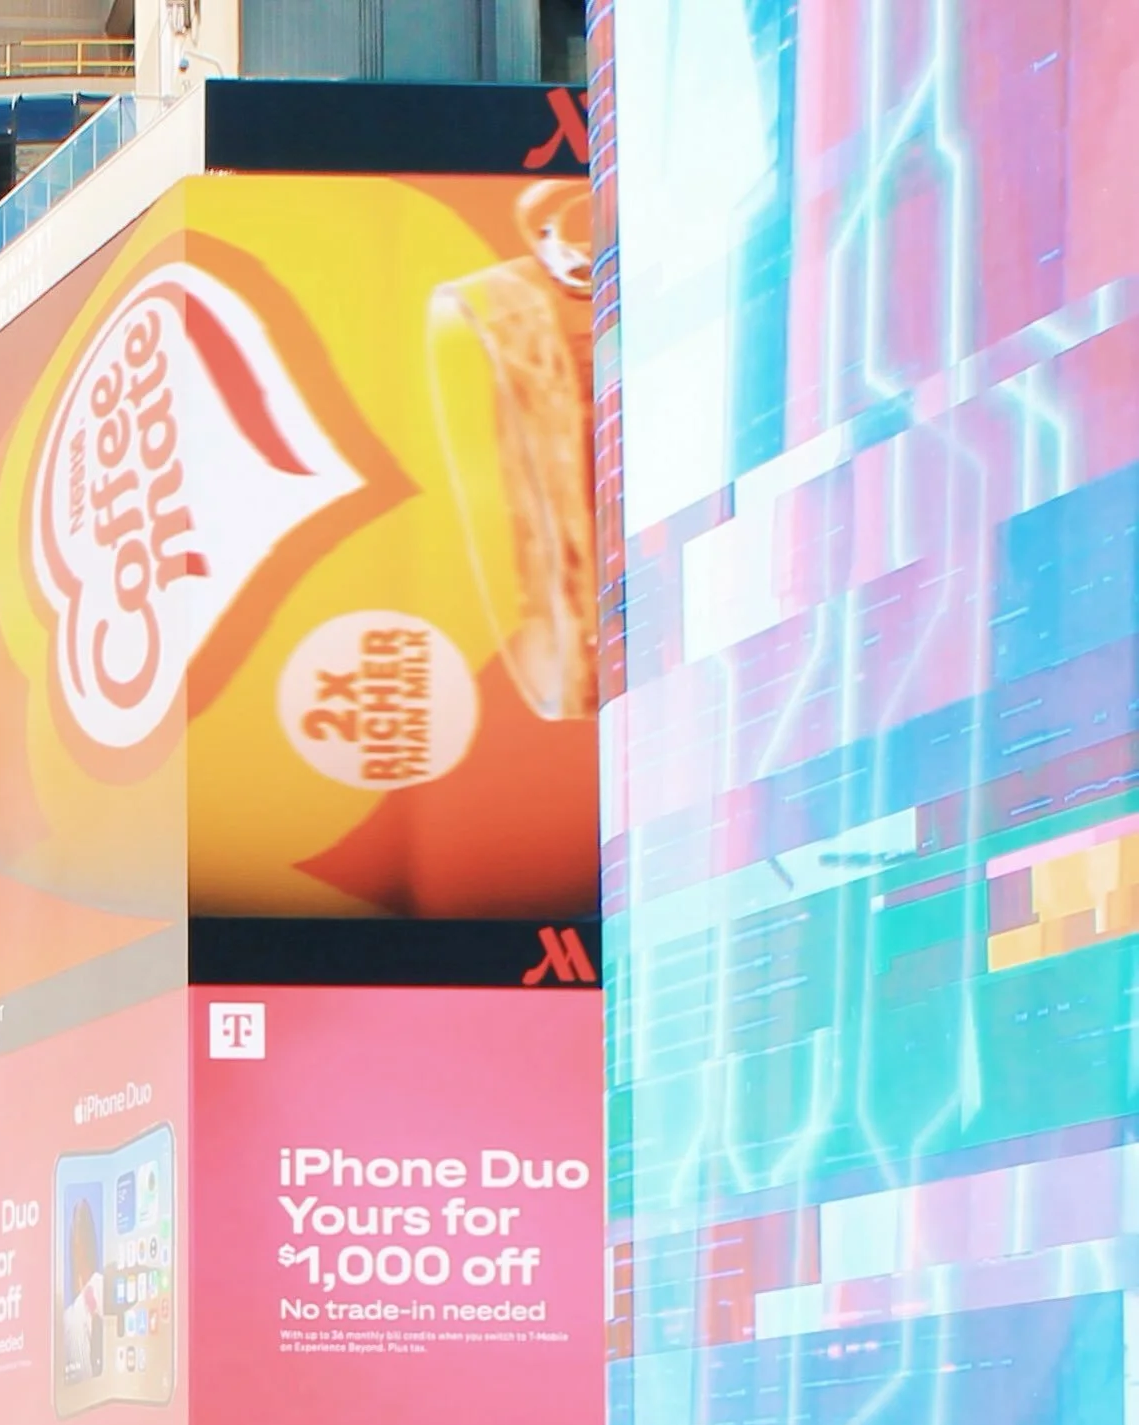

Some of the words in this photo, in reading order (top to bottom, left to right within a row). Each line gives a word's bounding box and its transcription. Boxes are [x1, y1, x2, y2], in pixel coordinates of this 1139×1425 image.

[90, 360, 160, 709] Coffee
[404, 629, 431, 699] MILK
[363, 629, 401, 780] RICHER
[404, 708, 431, 778] THAN
[84, 1091, 125, 1123] iPhone
[126, 1082, 152, 1110] Duo
[279, 1149, 467, 1189] iPhone
[481, 1151, 589, 1189] Duo
[2, 1199, 39, 1234] Duo
[279, 1198, 430, 1236] Yours
[442, 1198, 519, 1236] for
[278, 1246, 450, 1291] $1,000
[462, 1247, 540, 1286] off
[279, 1299, 317, 1322] No
[324, 1299, 436, 1322] trade-in
[443, 1300, 547, 1323] needed
[280, 1330, 303, 1341] With
[305, 1332, 318, 1343] up
[320, 1331, 330, 1341] to
[331, 1330, 344, 1341] 36
[346, 1330, 384, 1343] monthly
[386, 1330, 401, 1341] bill
[403, 1330, 436, 1341] credits
[438, 1331, 463, 1342] when
[465, 1333, 483, 1344] you
[485, 1331, 514, 1342] switch
[517, 1332, 527, 1342] to
[529, 1331, 569, 1342] T-Mobile
[280, 1344, 292, 1352] on
[294, 1342, 346, 1354] Experience
[348, 1342, 386, 1354] Beyond.
[388, 1343, 408, 1352] Plus
[410, 1343, 427, 1352] tax.
